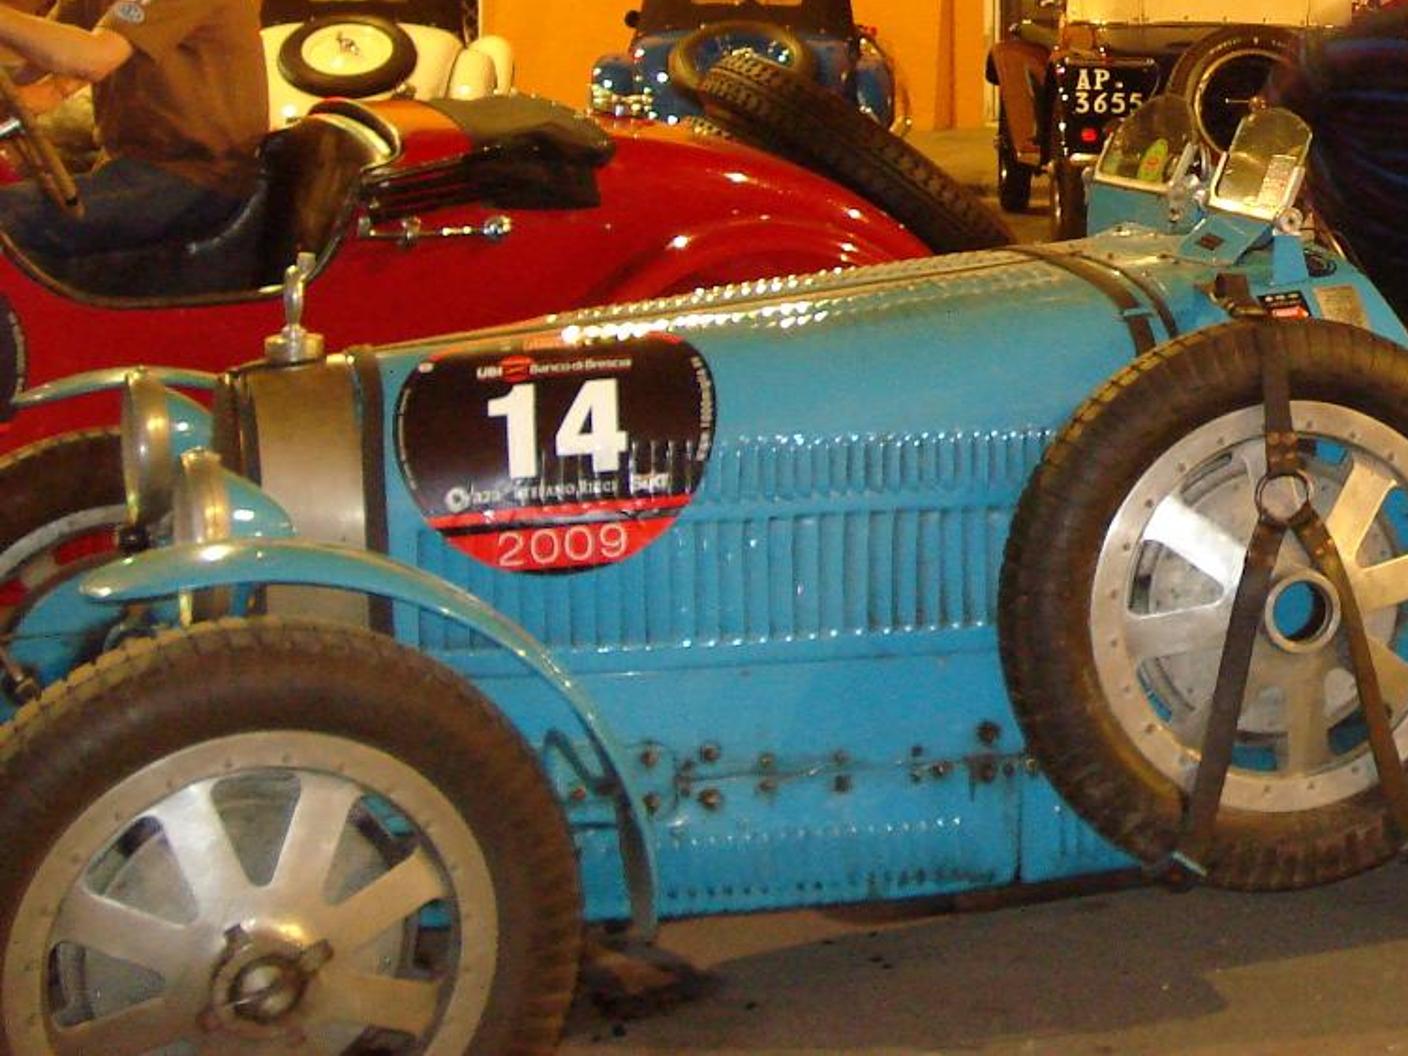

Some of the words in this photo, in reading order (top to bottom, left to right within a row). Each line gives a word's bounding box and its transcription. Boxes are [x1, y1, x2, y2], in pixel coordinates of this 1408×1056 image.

[1075, 92, 1143, 114] 3655
[487, 377, 630, 479] 14
[497, 523, 629, 567] 2009
